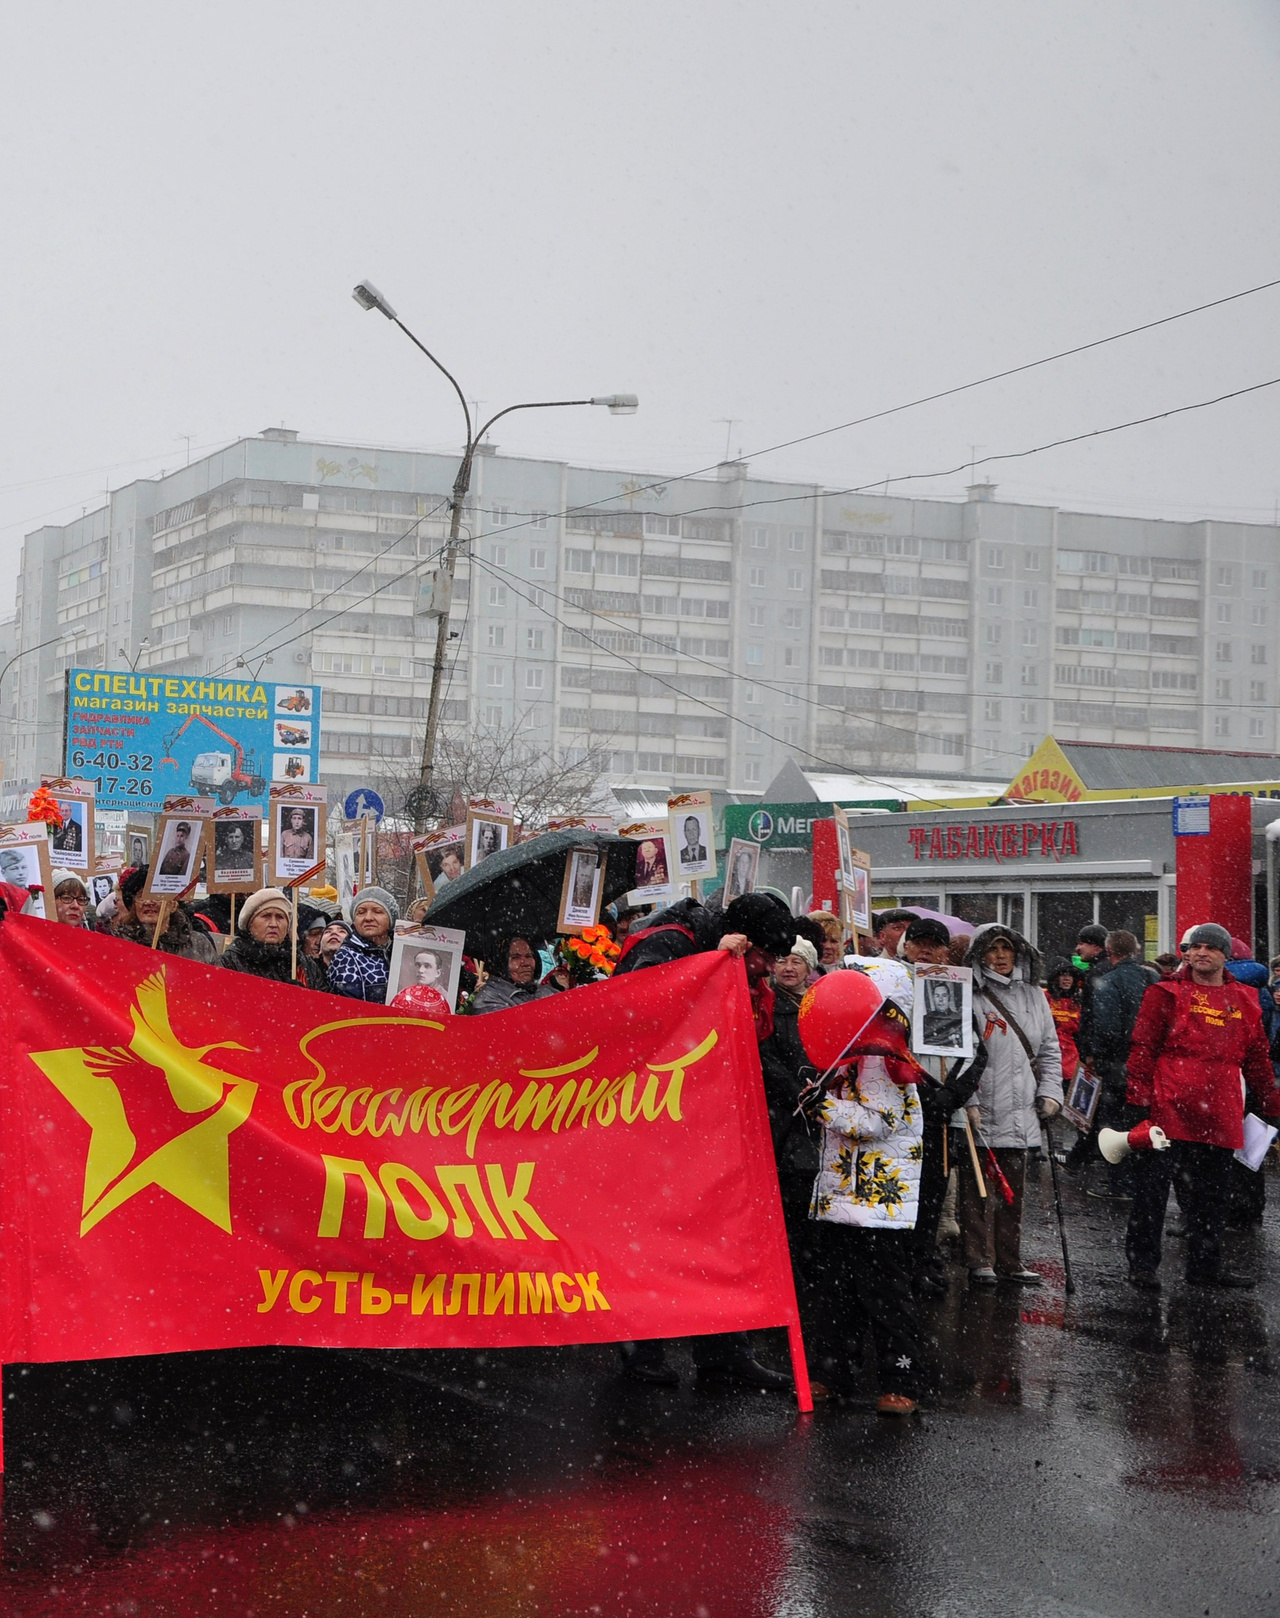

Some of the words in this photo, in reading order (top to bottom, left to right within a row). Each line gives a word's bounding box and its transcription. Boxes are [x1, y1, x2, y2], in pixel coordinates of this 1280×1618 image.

[75, 673, 268, 704] СПЕЦТЕХНИКА
[72, 712, 151, 725] ГИДРАВЛИКА
[74, 696, 159, 712] магазин
[166, 702, 268, 720] запчастей
[72, 725, 135, 737] ЗАПЧАСТИ
[72, 737, 97, 749] РВД
[100, 738, 124, 749] РТИ
[72, 750, 153, 772] 6-40-32
[72, 775, 153, 796] 17-26
[95, 798, 165, 809] нтернационал
[907, 821, 1078, 864] ТАБАКЕРКА
[318, 1154, 558, 1241] ПОЛК
[257, 1270, 611, 1316] УСТЬ-ИЛИМСК
